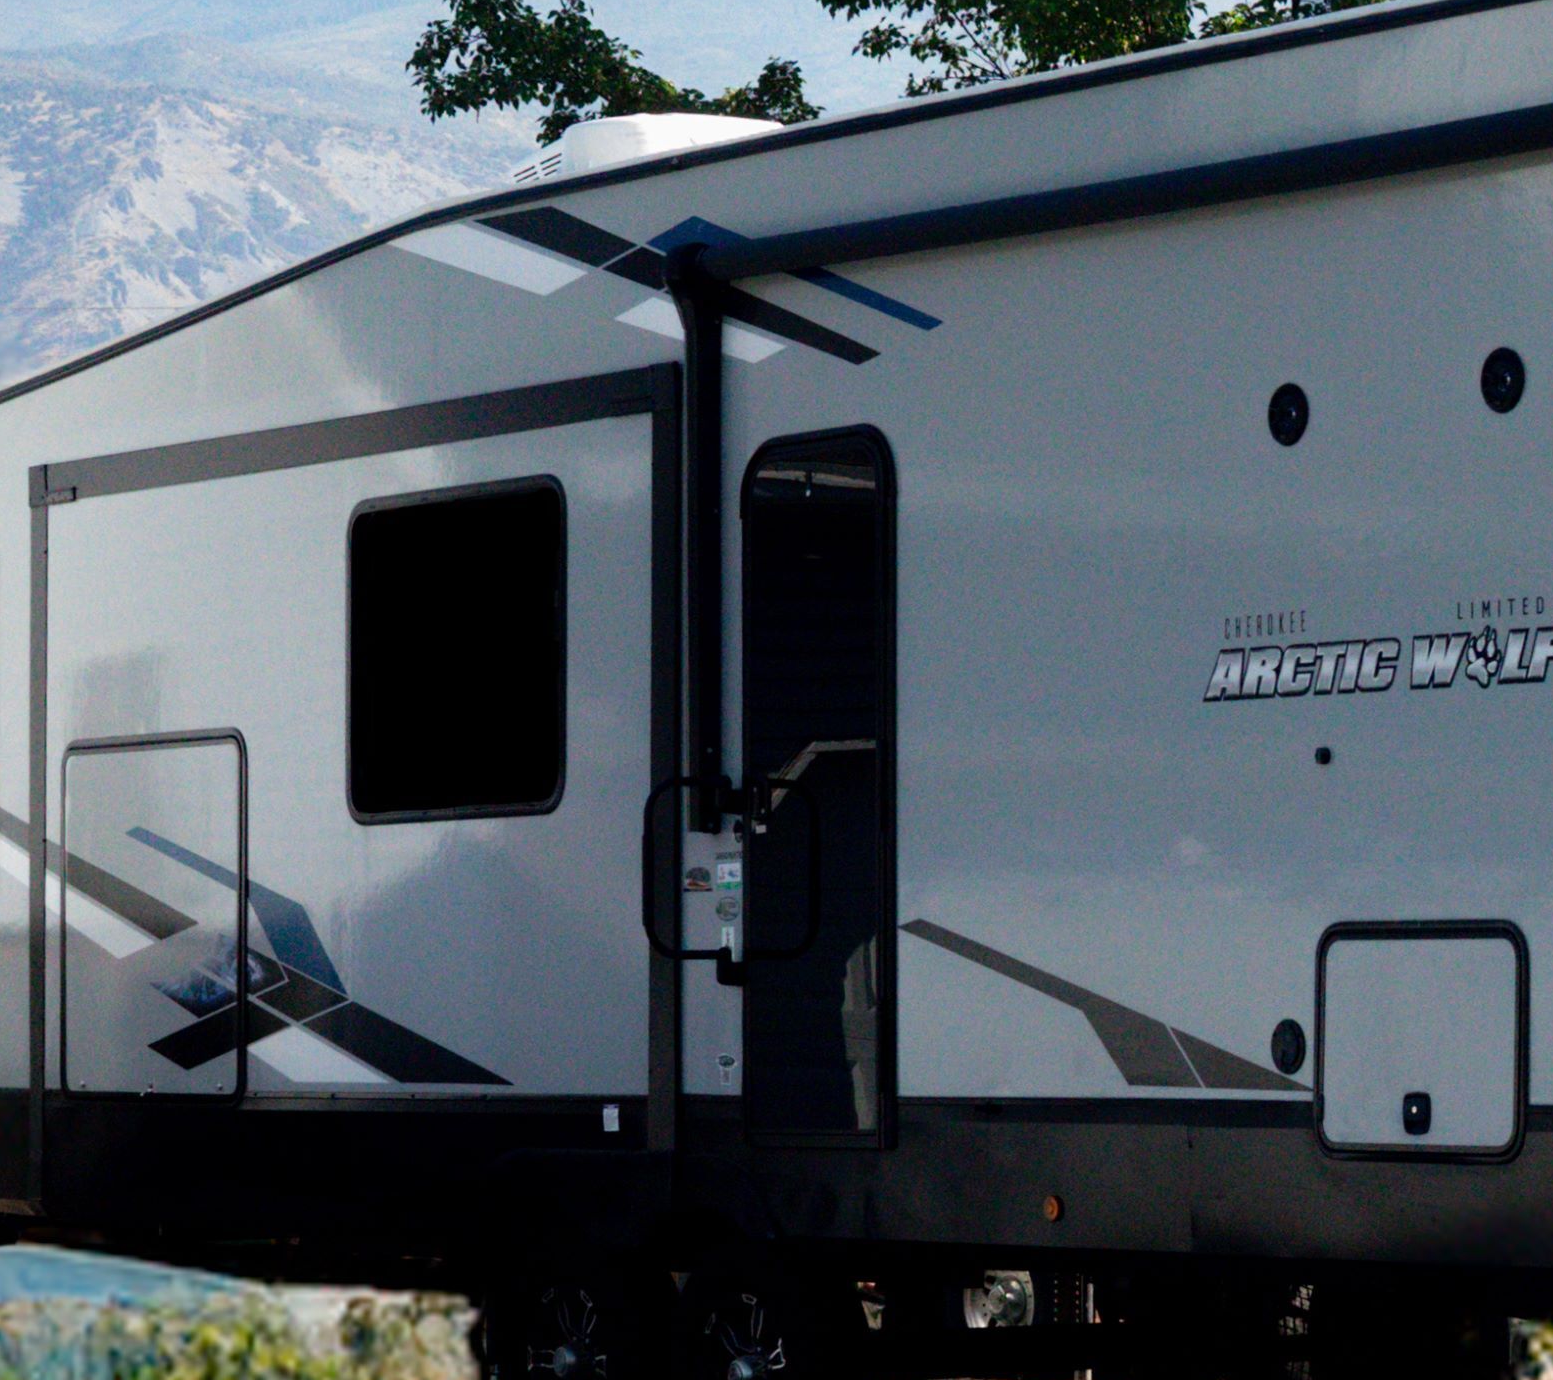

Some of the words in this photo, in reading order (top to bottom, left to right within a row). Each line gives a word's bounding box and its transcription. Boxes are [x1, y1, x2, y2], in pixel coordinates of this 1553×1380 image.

[1224, 611, 1307, 640] CHEROKEE
[1456, 596, 1545, 620] LIMITED
[1203, 637, 1401, 702] ARCTIC
